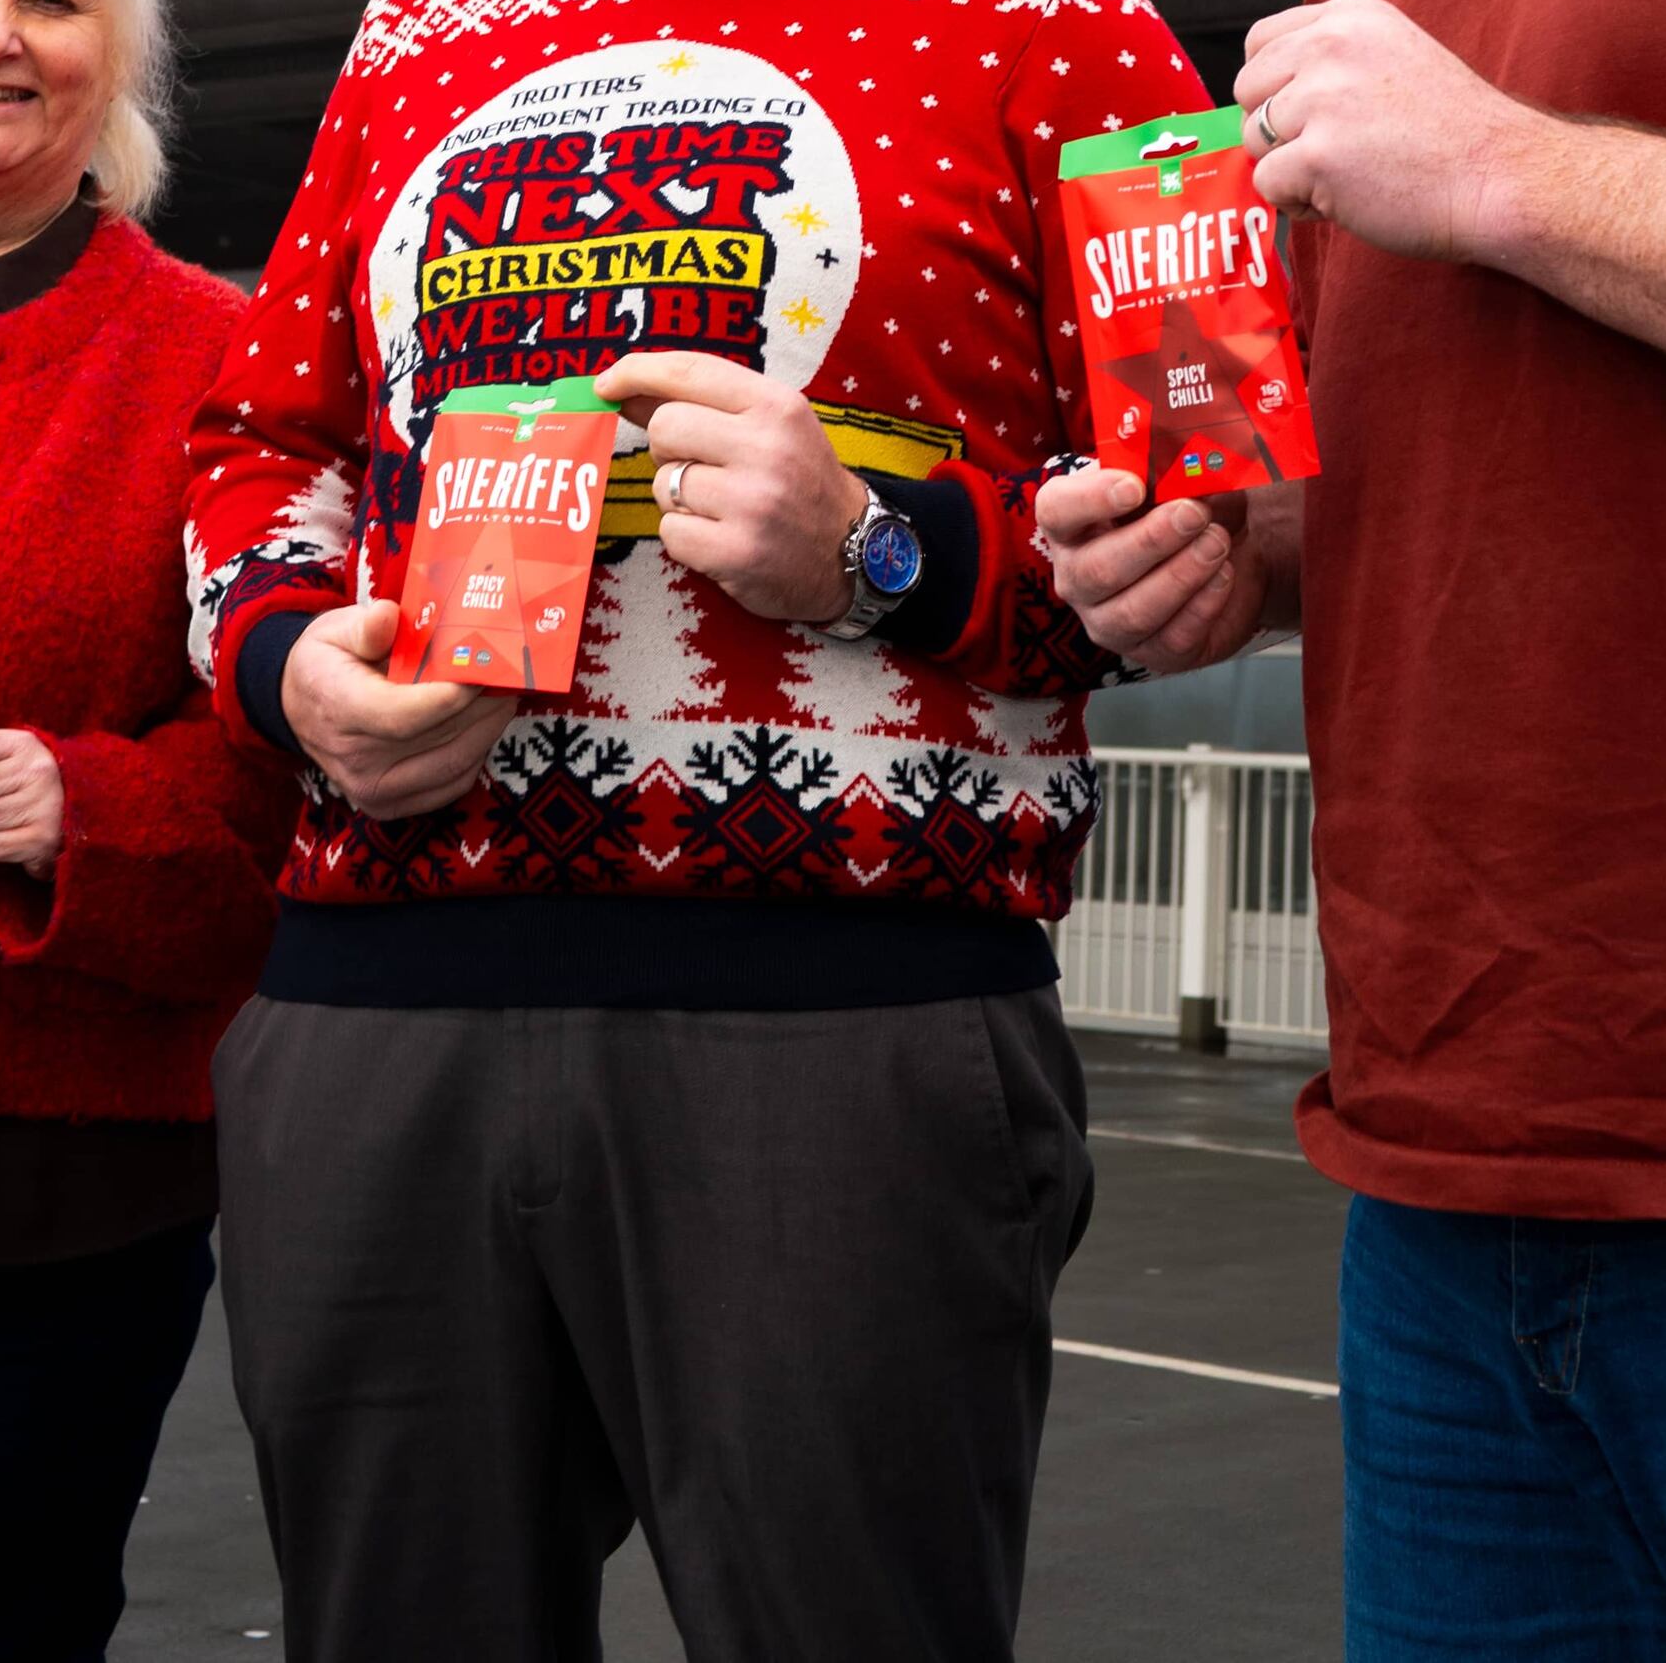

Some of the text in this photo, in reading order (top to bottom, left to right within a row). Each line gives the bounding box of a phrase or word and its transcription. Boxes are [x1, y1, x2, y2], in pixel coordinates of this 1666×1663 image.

[441, 97, 806, 152] INDEPENDENT TRADING CO
[441, 124, 783, 190] THIS TIME
[424, 164, 779, 261] NEXT
[428, 236, 751, 304] CHRISTMAS
[1137, 284, 1216, 308] BILTONG
[417, 287, 760, 358] WE'LL BE
[413, 346, 750, 405] MILLIONA
[1166, 363, 1206, 388] SPICY
[1167, 383, 1214, 409] CHILLI
[464, 514, 536, 525] BILTONG
[461, 592, 504, 610] CHILLI
[467, 574, 506, 592] SPICY
